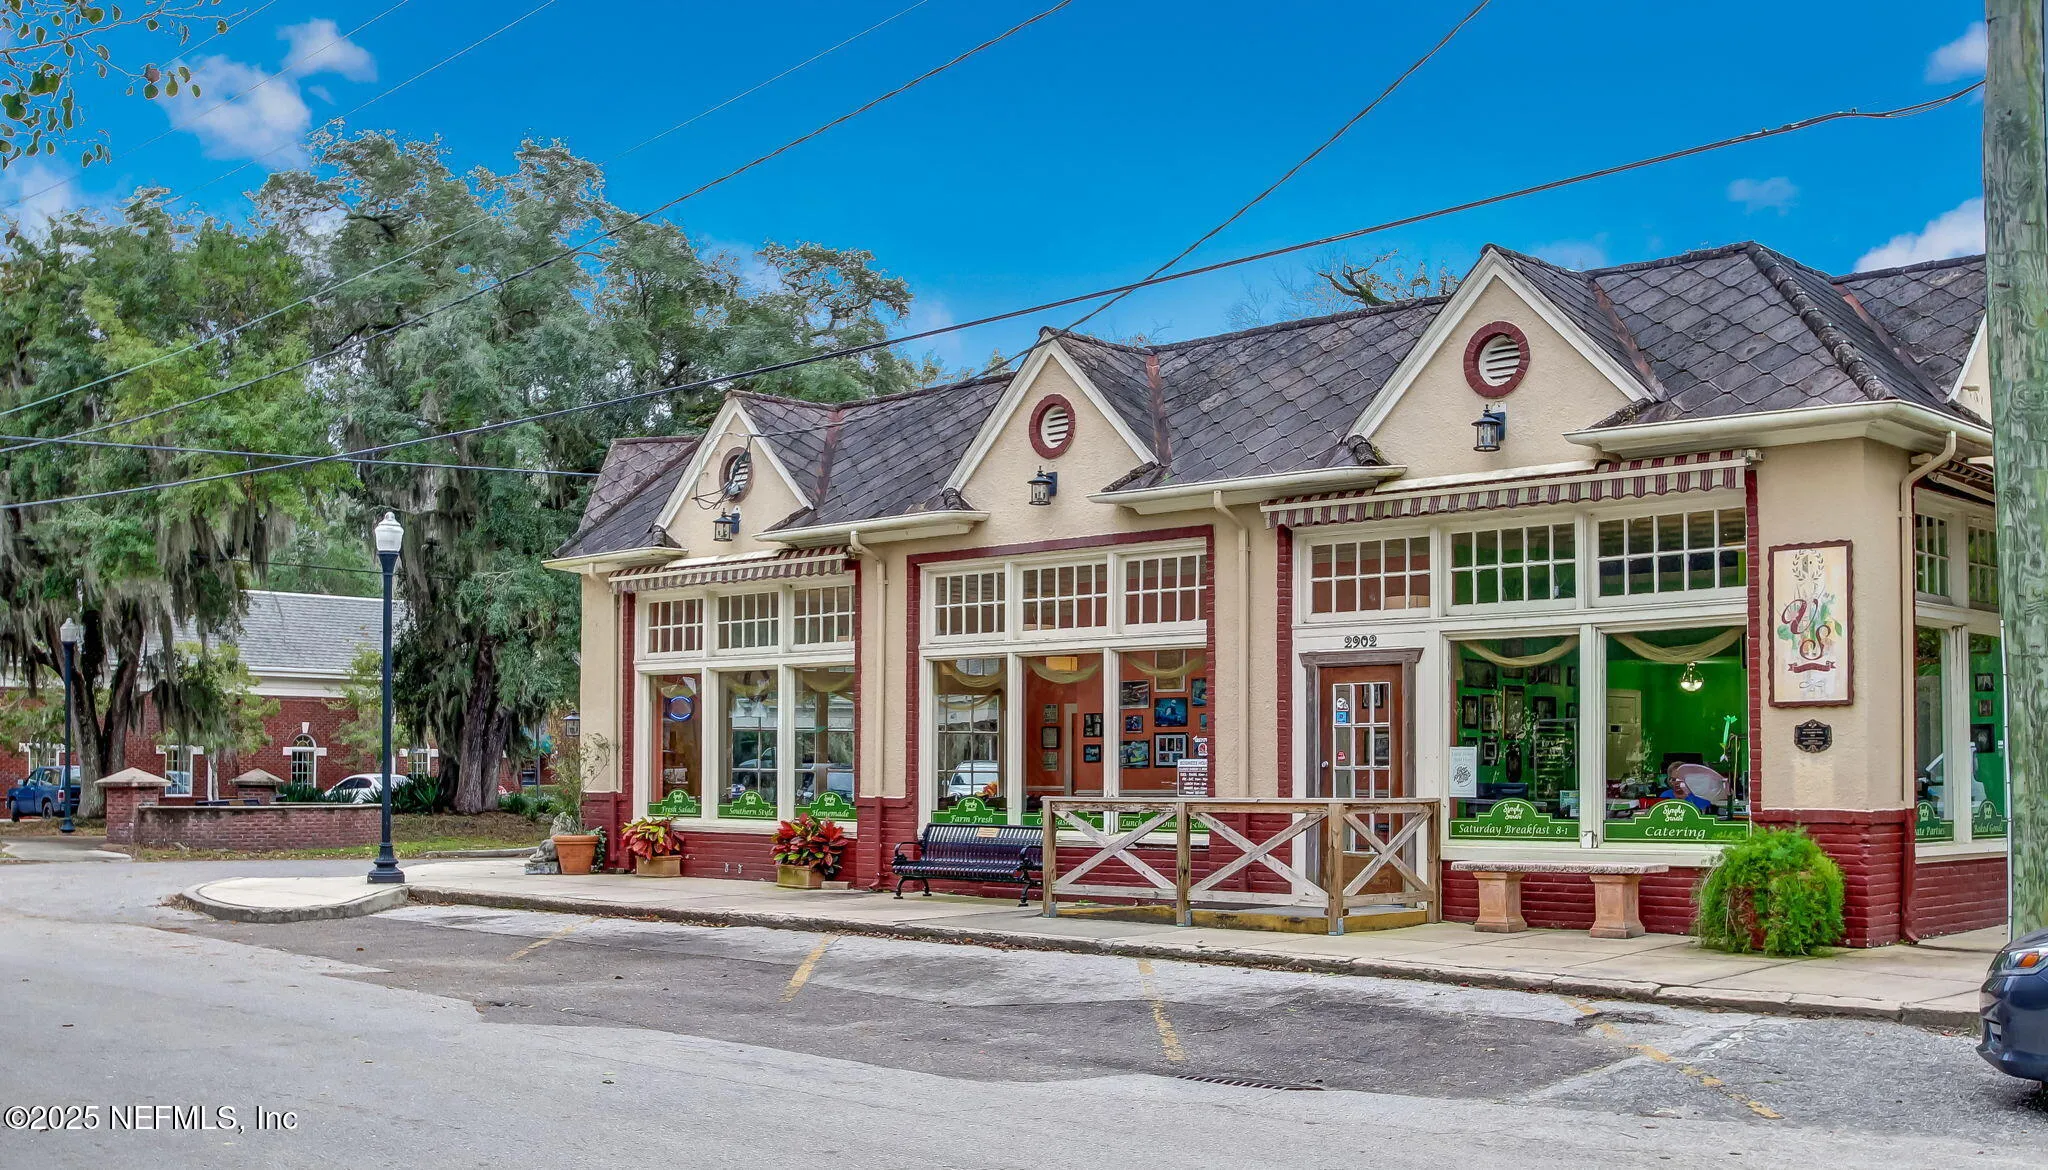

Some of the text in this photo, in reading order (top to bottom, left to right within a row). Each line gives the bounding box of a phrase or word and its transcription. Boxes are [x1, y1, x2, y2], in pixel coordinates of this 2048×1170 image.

[1344, 635, 1377, 648] 2902
[728, 808, 774, 817] Southern Style
[811, 809, 850, 817] Homemade
[950, 815, 993, 824] Farm Fresh
[1121, 818, 1143, 827] Lunch
[1459, 823, 1568, 837] Saturday Breakfast 8-1
[1645, 826, 1706, 840] Catering
